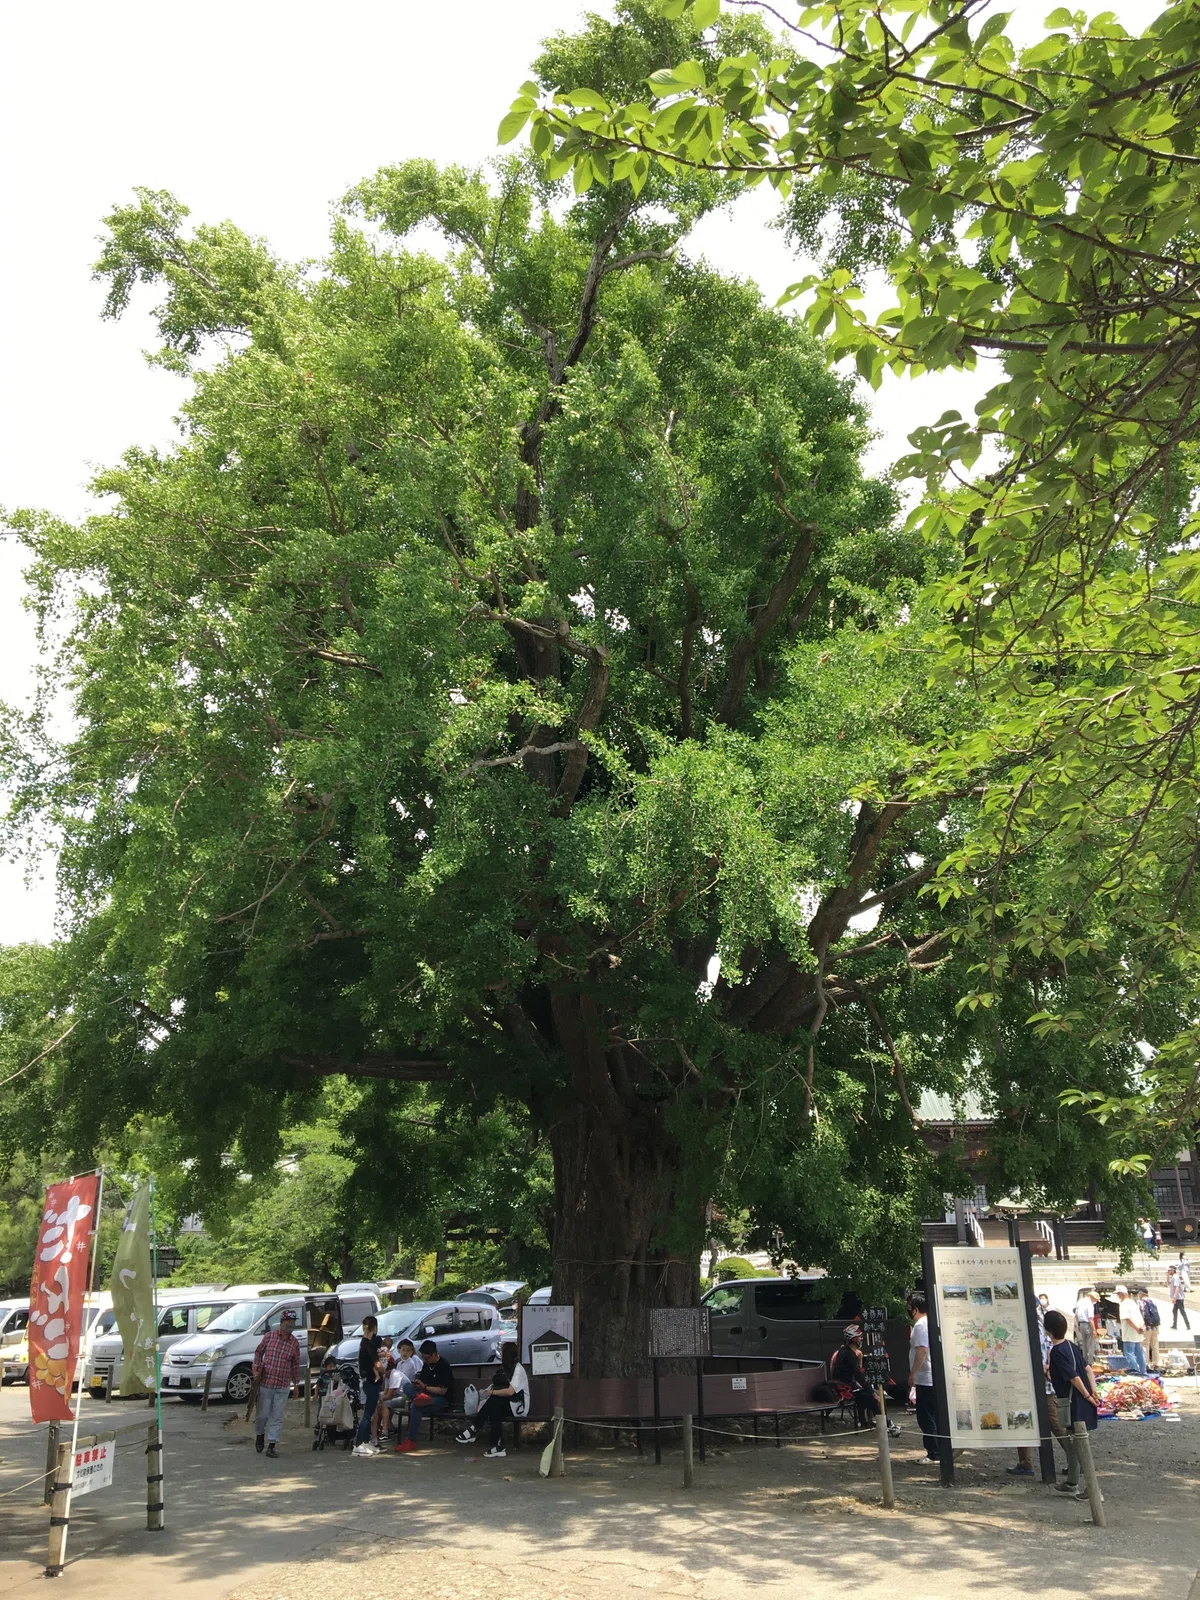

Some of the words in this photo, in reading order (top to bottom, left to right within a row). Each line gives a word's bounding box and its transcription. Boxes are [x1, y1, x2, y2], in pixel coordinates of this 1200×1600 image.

[861, 1309, 884, 1320] 寺務所
[75, 1446, 107, 1467] 駐車禁止
